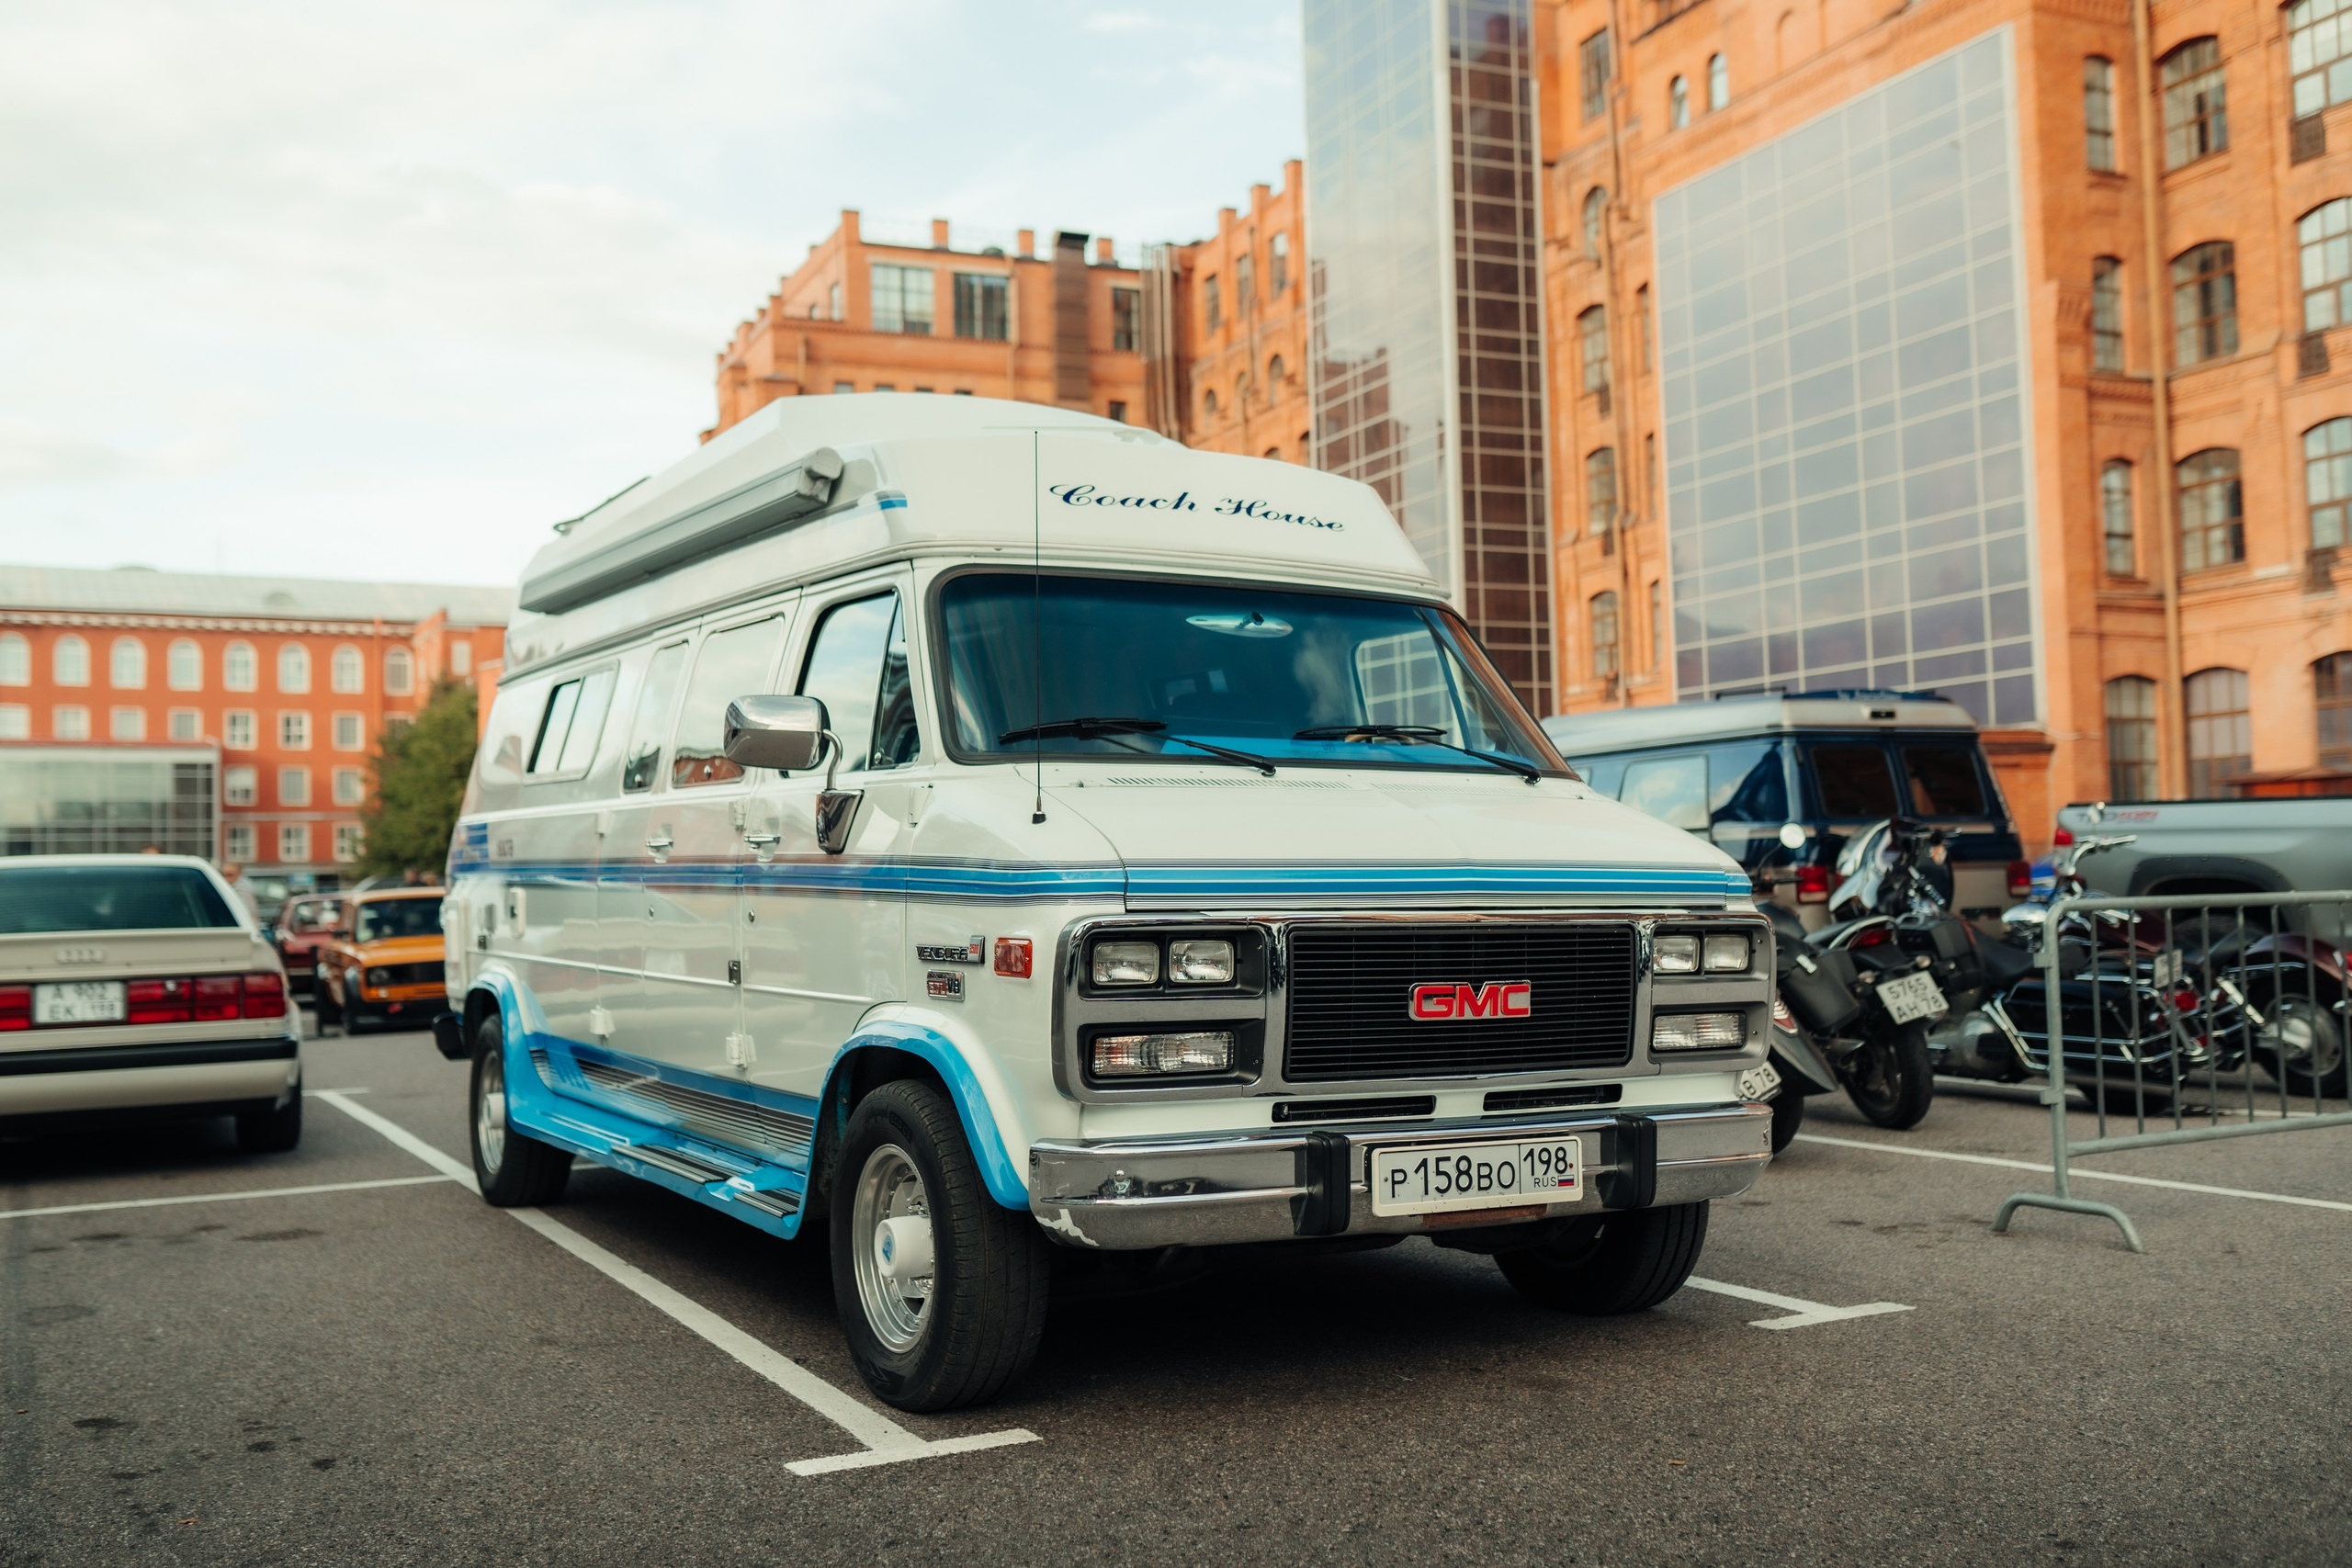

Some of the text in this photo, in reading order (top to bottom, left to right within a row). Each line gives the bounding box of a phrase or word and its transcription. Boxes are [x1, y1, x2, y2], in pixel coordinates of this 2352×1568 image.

[1049, 484, 1345, 533] Coach House
[947, 978, 961, 995] V8
[1886, 976, 1928, 1000] 5765
[1413, 984, 1530, 1019] GMC
[1522, 1145, 1568, 1176] 198
[1533, 1176, 1557, 1189] RUS
